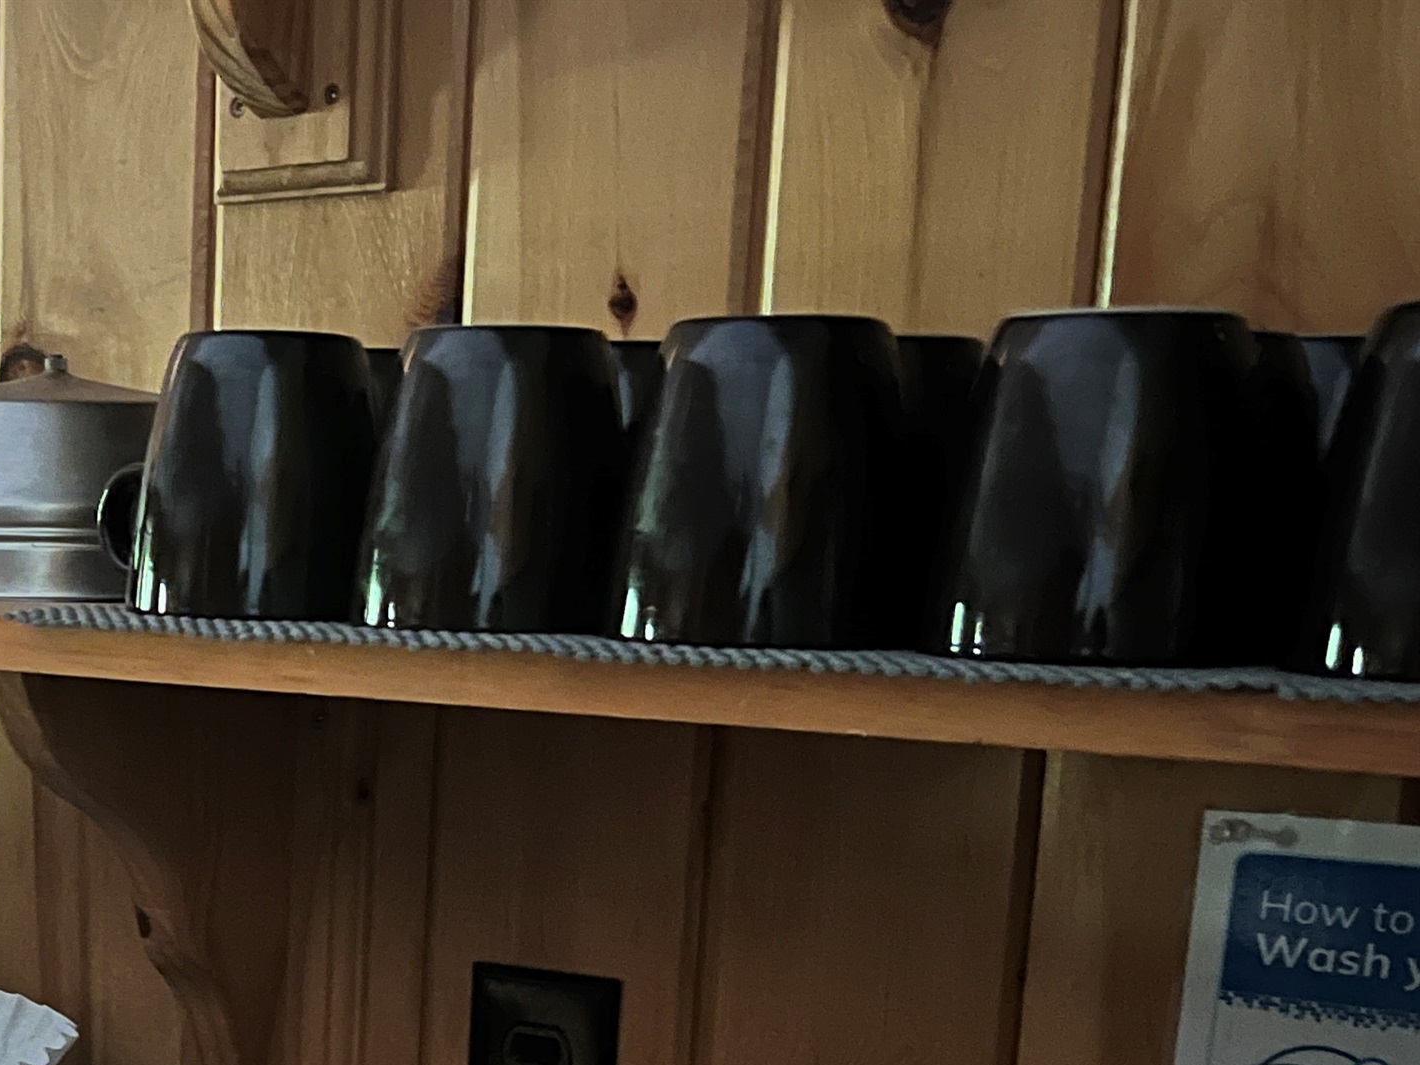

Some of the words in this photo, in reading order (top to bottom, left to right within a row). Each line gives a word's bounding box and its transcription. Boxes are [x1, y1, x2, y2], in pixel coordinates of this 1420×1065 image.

[1259, 889, 1361, 929] How
[1372, 901, 1416, 935] to
[1256, 931, 1392, 980] Wash
